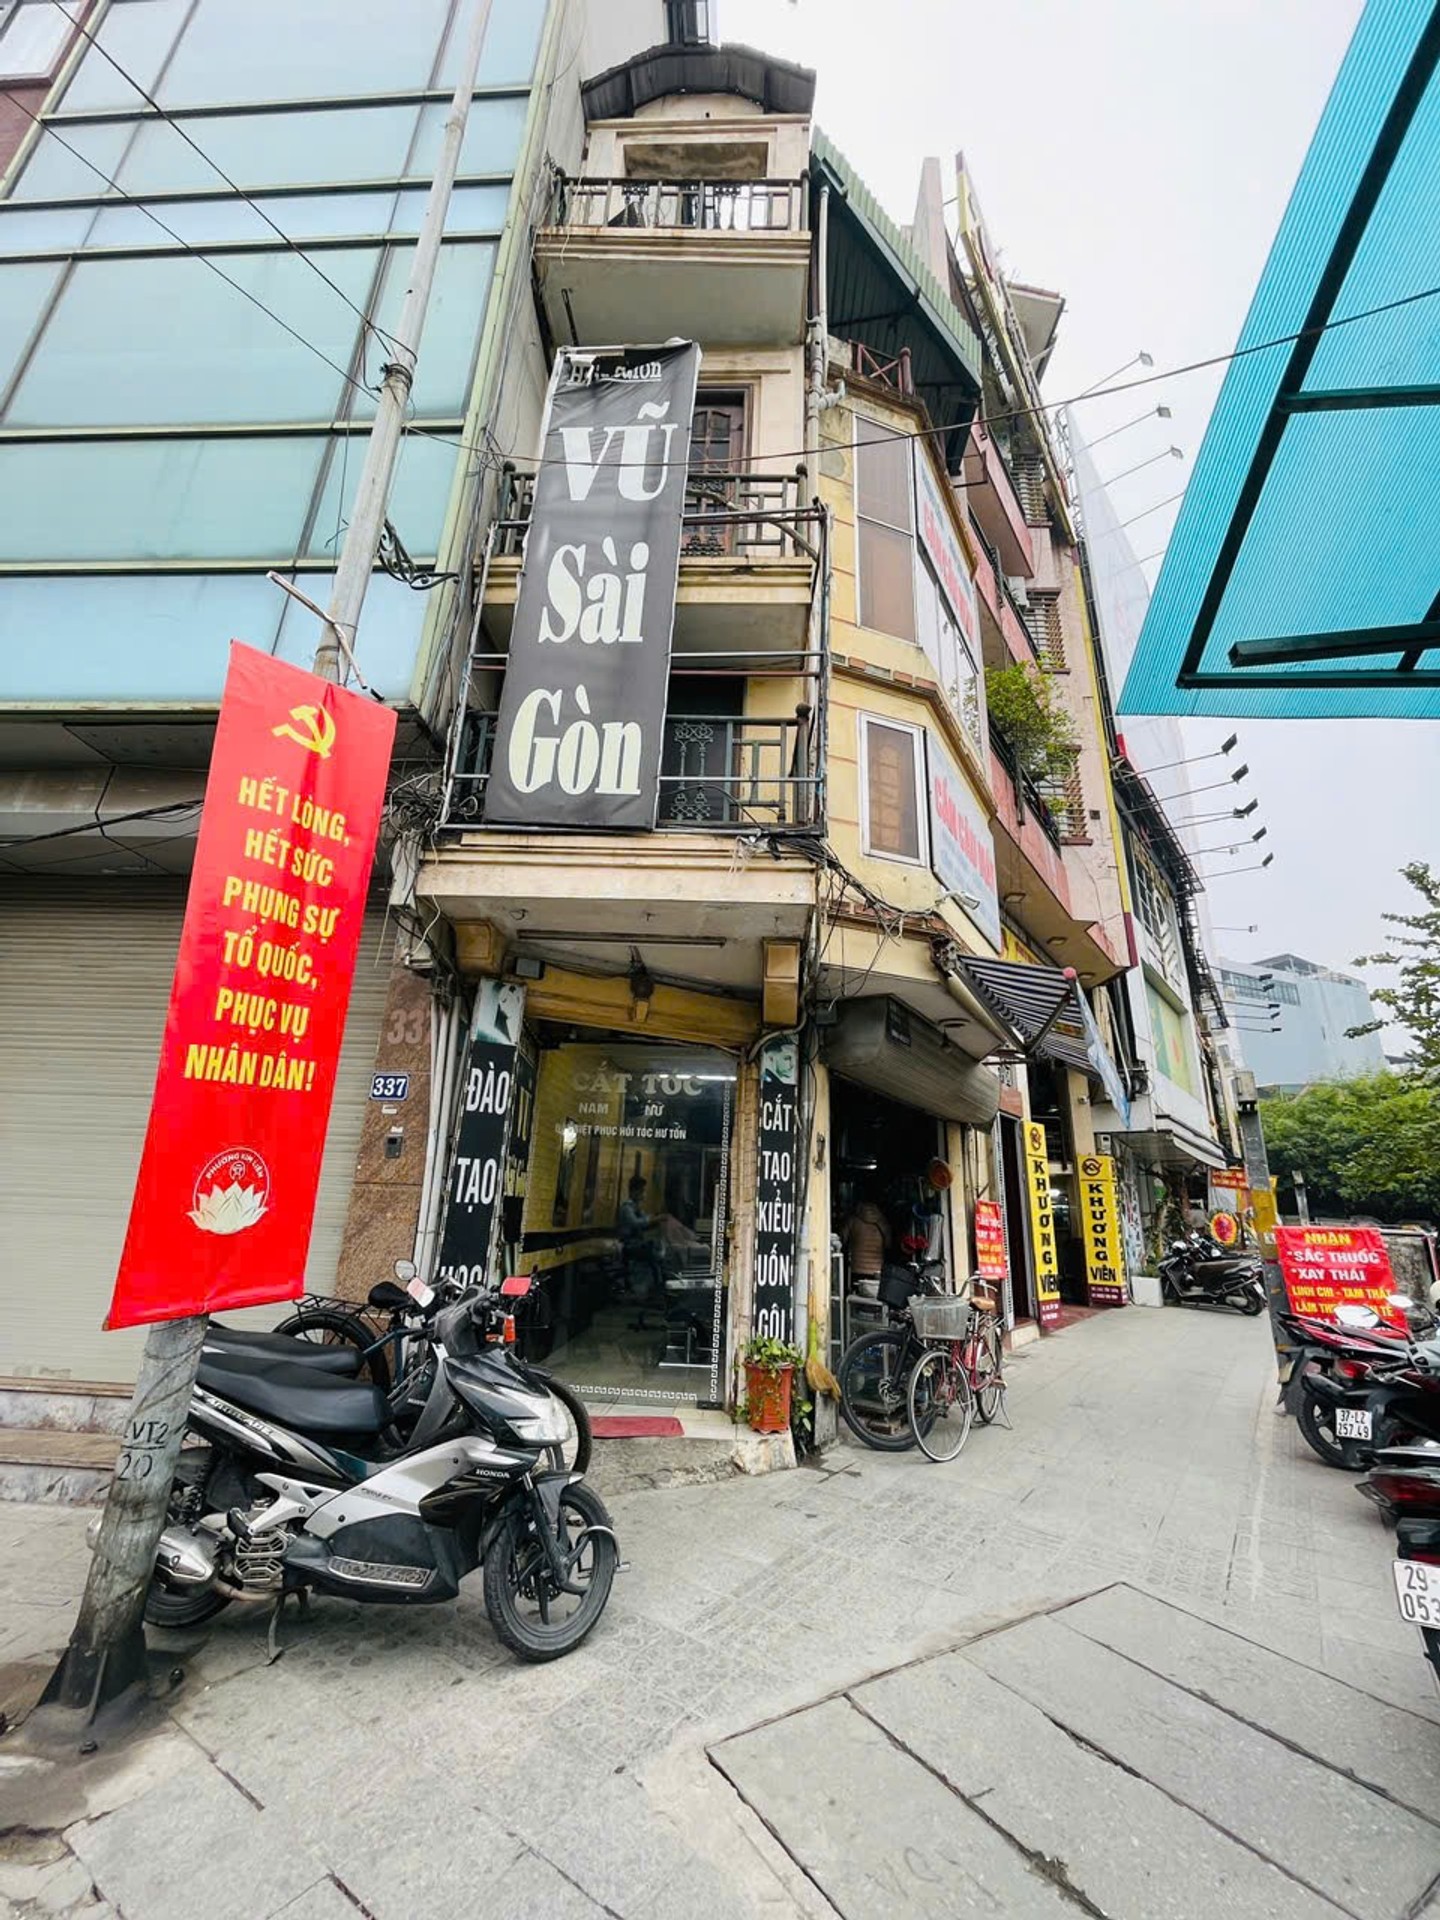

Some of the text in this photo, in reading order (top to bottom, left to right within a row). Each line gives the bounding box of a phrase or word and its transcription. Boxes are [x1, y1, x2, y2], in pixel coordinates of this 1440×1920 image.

[559, 401, 678, 501] VŨ
[538, 537, 650, 644] Sài
[508, 684, 642, 795] Gòn
[238, 776, 350, 847] HẾT LÒNG,
[244, 827, 334, 887] HẾT SỨC
[223, 875, 341, 944] PHỤNG SỰ
[223, 925, 318, 991] TỔ QUỐC,
[215, 987, 310, 1044] PHỤC VỤ
[184, 1042, 316, 1092] NHÂN DÂN!
[372, 1077, 407, 1097] 337
[465, 1061, 510, 1115] ĐÀO
[578, 1102, 609, 1115] NAM
[763, 1094, 792, 1131] CẮT
[455, 1157, 498, 1213] TẠO
[762, 1151, 791, 1187] TẠO
[758, 1189, 792, 1233] KIỂU
[1033, 1160, 1053, 1266] KHƯƠNG
[1088, 1183, 1110, 1262] KHƯƠNG
[757, 1243, 790, 1287] UỐN
[1296, 1268, 1326, 1281] XAY
[1316, 1286, 1335, 1298] CHI
[475, 1467, 511, 1479] HONDA
